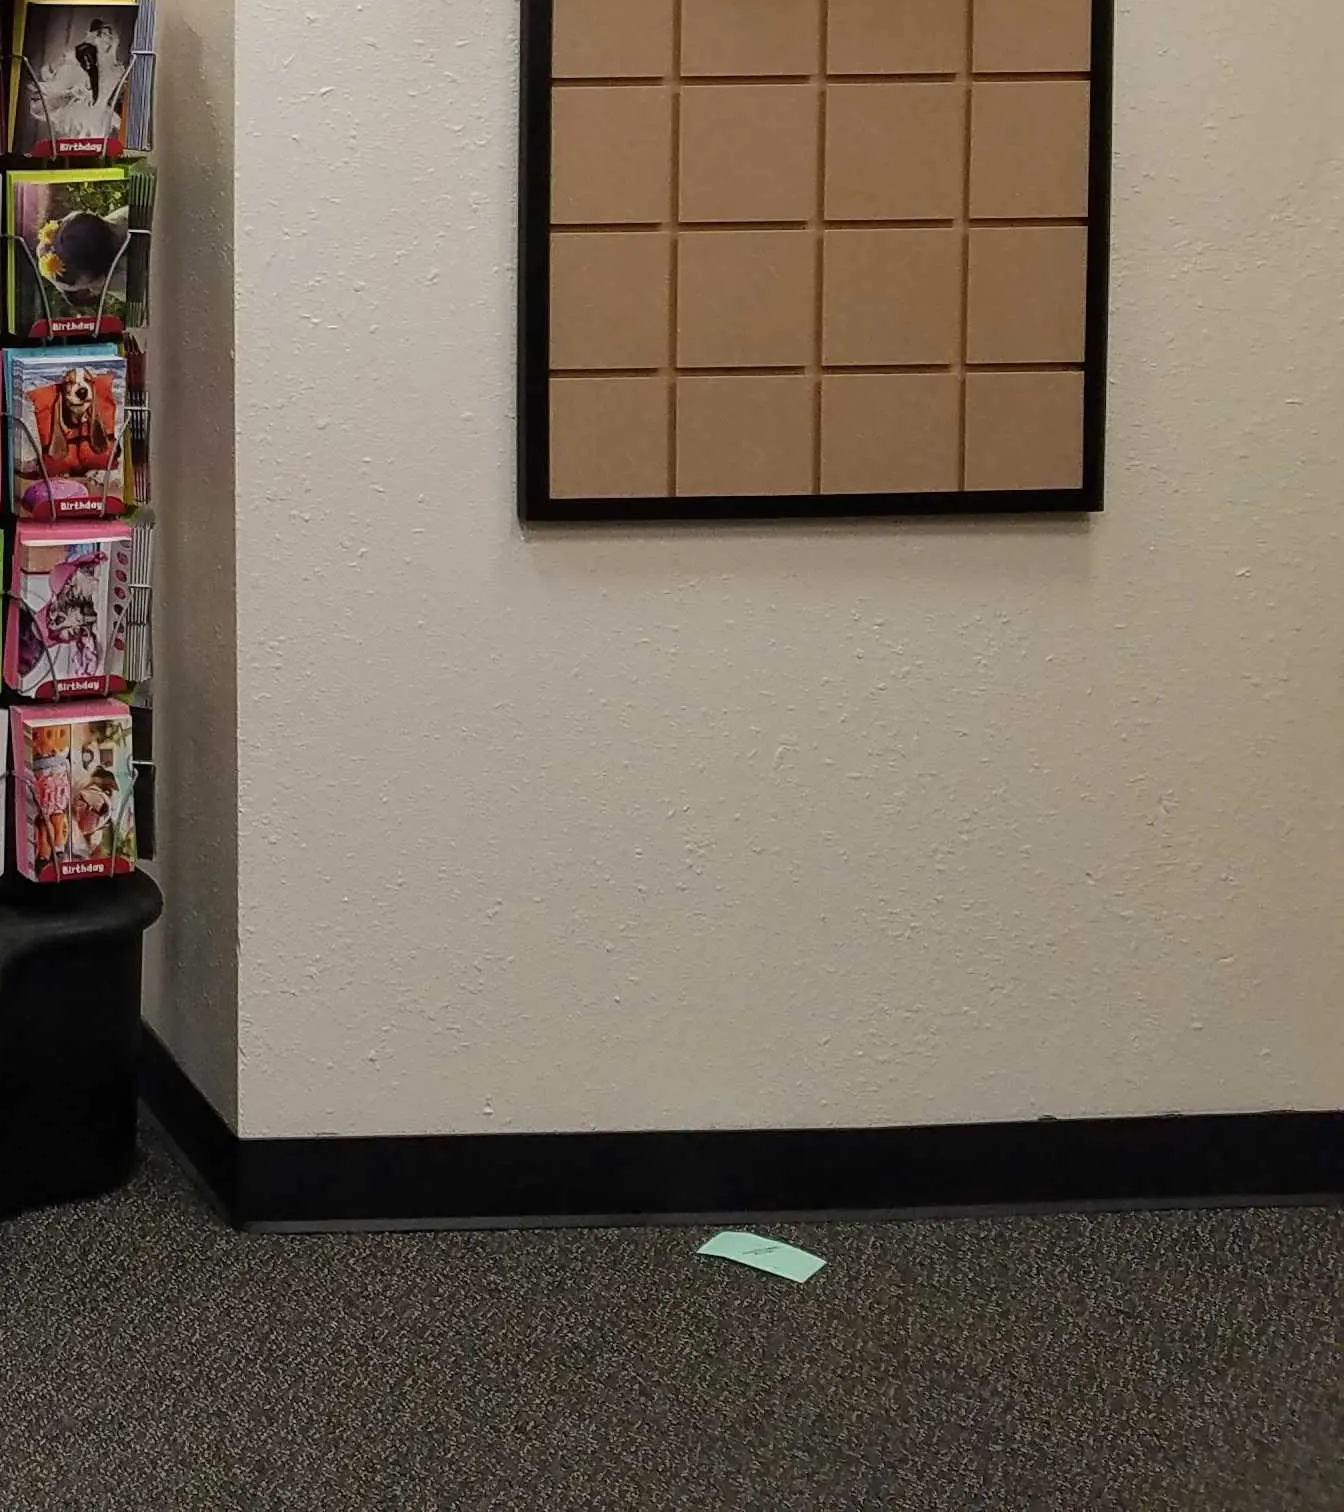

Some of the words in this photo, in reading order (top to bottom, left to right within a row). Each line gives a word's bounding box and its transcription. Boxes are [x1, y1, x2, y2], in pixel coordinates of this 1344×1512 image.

[59, 142, 103, 153] Birthday
[52, 320, 95, 331] Birthday
[60, 501, 104, 512] Birthday
[57, 680, 100, 692] Birthday
[62, 863, 105, 875] Birthday
